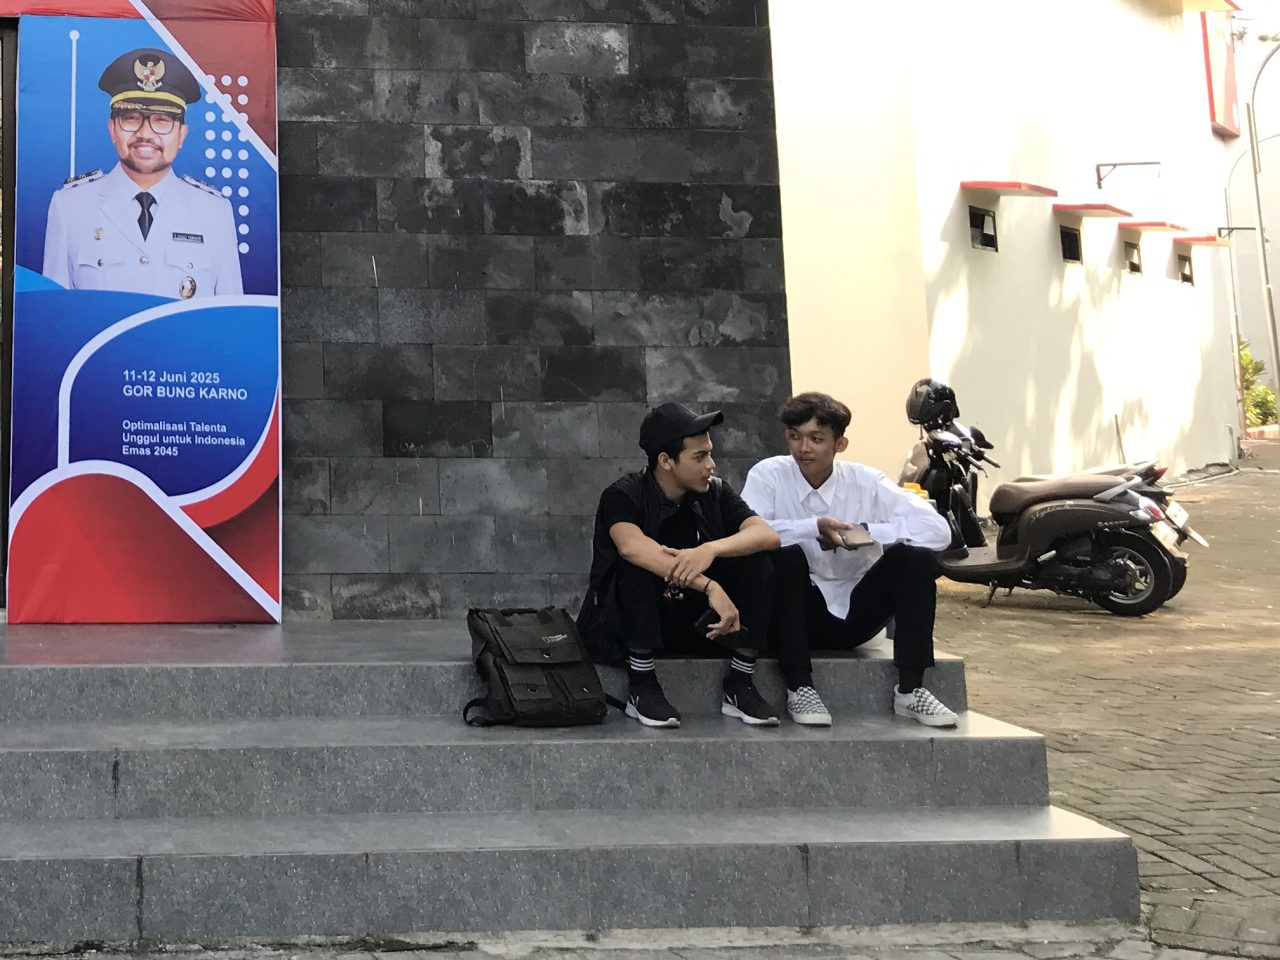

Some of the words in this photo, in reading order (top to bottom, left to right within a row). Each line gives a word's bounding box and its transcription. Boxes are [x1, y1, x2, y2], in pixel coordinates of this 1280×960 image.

[123, 369, 156, 382] 11-12
[159, 371, 187, 383] Juni
[190, 372, 220, 384] 2025
[123, 385, 153, 397] GOR
[157, 386, 195, 398] BUNG
[199, 387, 248, 400] KARNO
[122, 420, 187, 432] Optimalisasi
[189, 422, 227, 433] Talenta
[122, 432, 159, 445] Unggul
[162, 434, 192, 445] untuk
[195, 434, 245, 446] Indonesia
[122, 445, 151, 455] Emas
[154, 446, 179, 456] 2045
